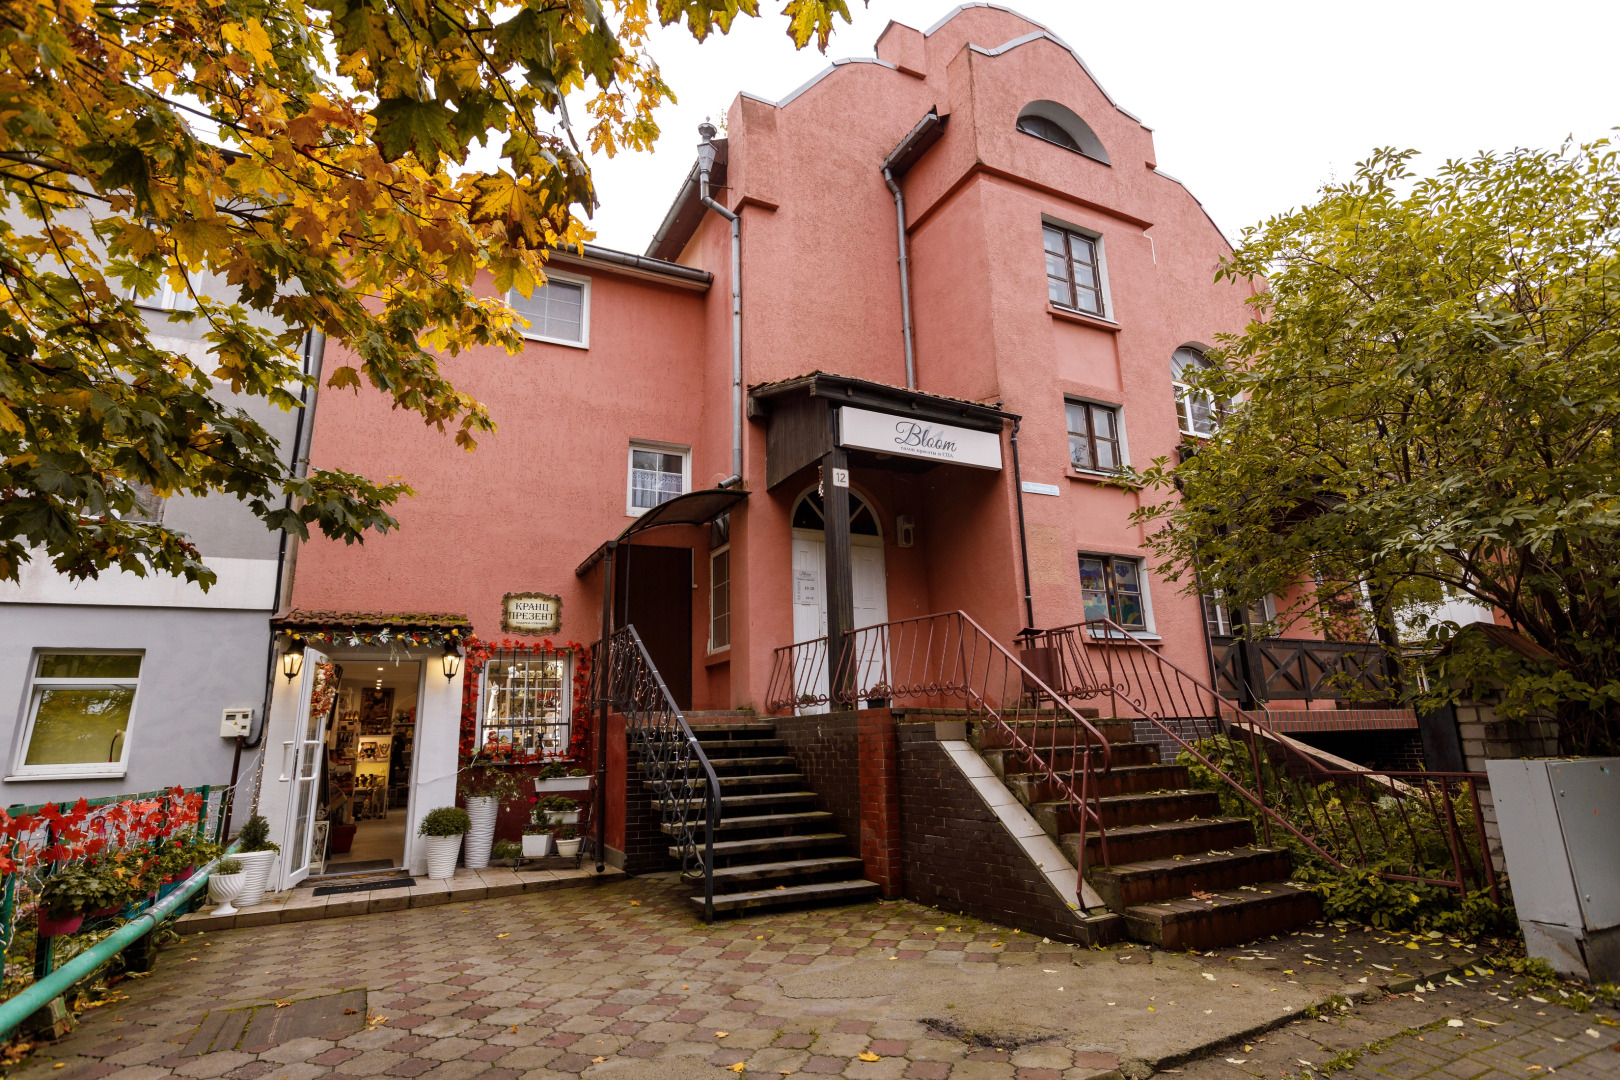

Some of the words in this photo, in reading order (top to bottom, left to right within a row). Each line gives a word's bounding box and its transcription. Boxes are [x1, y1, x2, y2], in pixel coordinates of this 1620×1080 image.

[894, 421, 958, 452] Bloom
[836, 472, 846, 483] 12
[515, 602, 549, 611] КРАНЦ
[508, 612, 555, 620] ПРЕЗЕНТ
